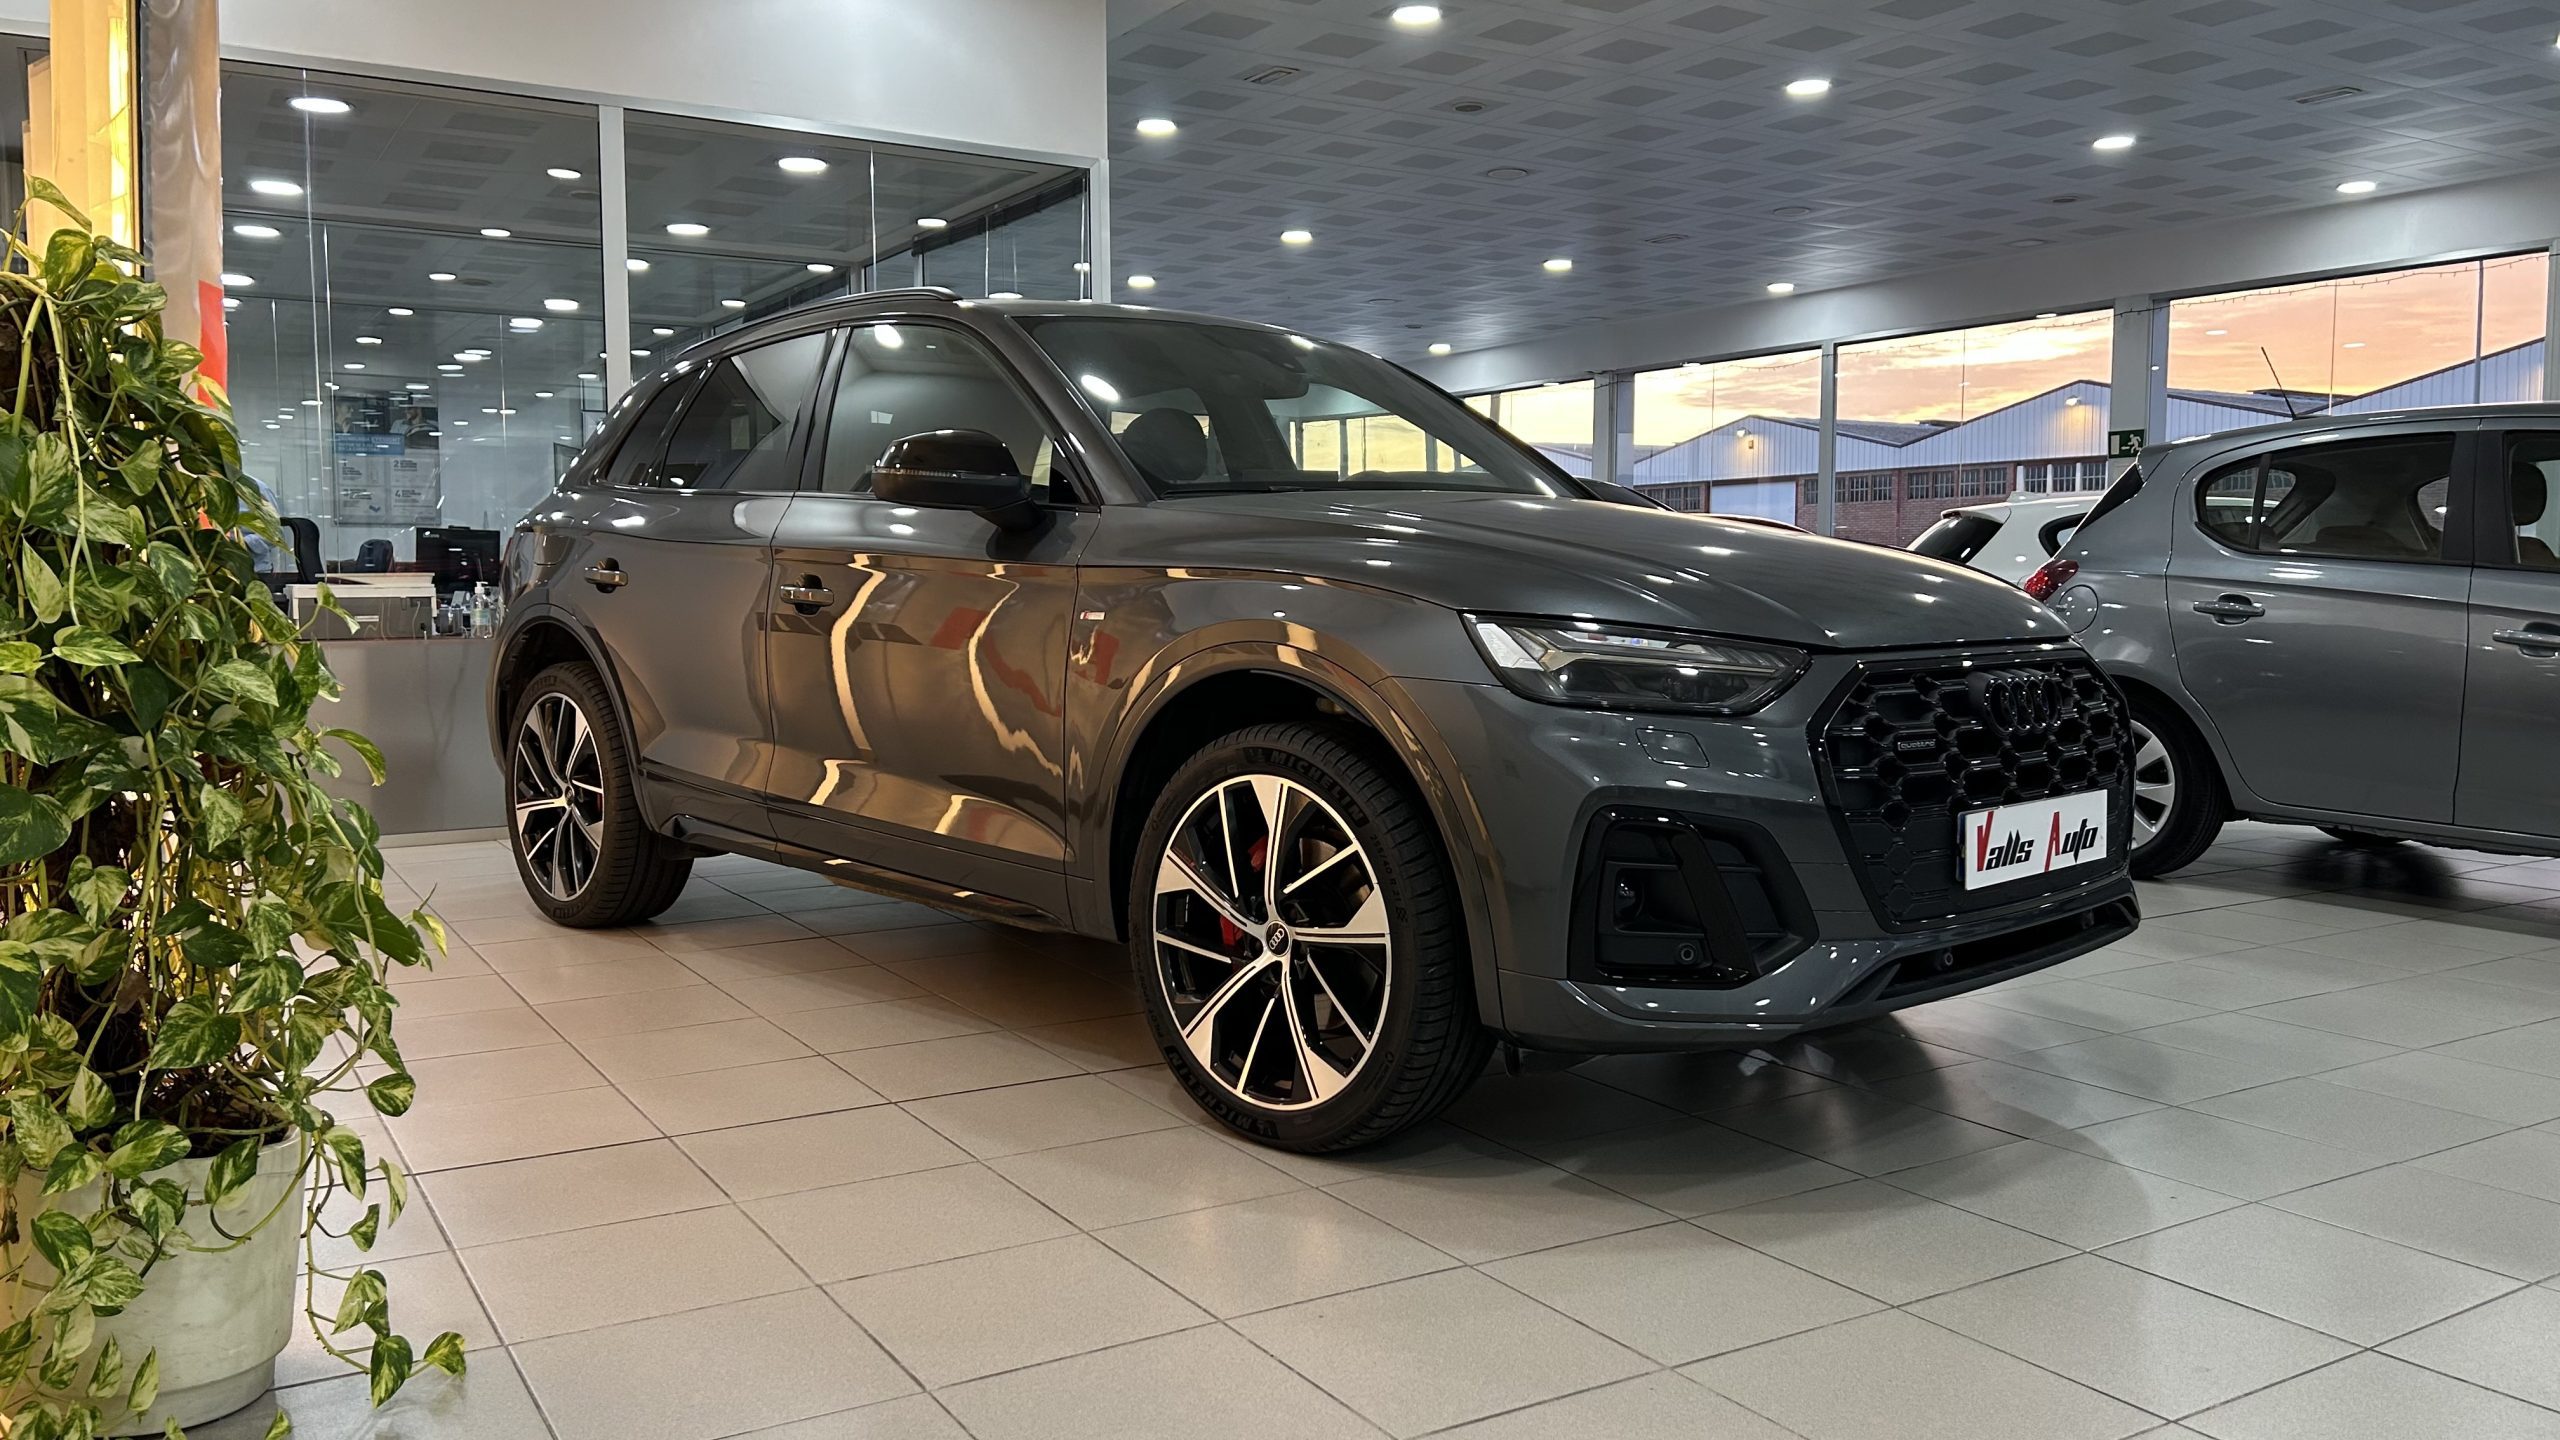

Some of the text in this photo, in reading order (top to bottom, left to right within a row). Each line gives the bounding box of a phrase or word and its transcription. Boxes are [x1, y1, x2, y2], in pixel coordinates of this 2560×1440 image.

[1899, 740, 1936, 750] quattro
[1269, 749, 1364, 825] MICHELIN
[1976, 810, 2099, 872] Valls Auto
[1168, 1052, 1252, 1129] MICHELIN
